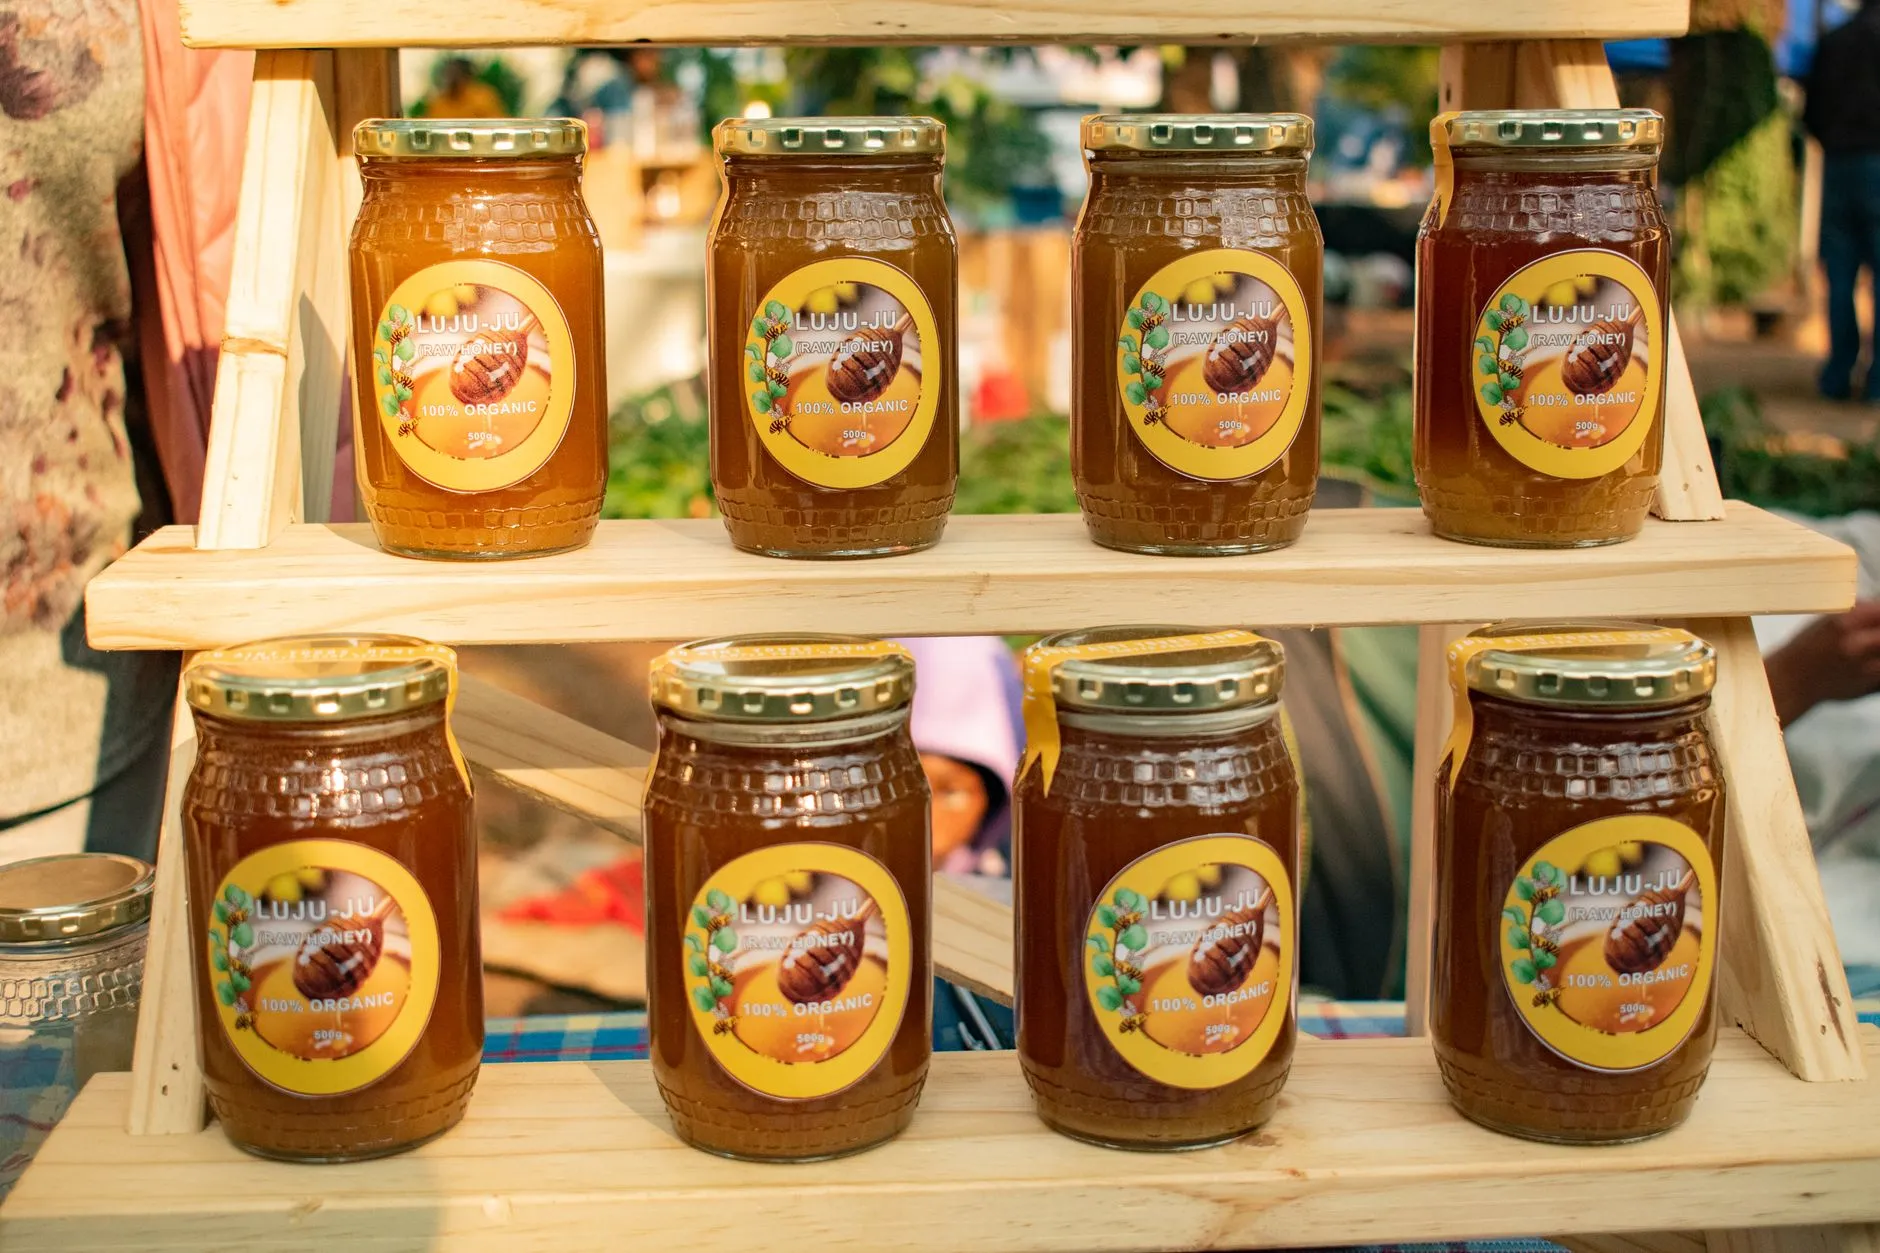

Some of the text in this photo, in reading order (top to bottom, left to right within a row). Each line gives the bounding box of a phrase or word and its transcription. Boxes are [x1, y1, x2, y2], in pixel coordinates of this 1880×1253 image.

[795, 311, 897, 331] LUJU-JU
[1173, 301, 1272, 322] LUJU-JU
[1532, 304, 1629, 324] LUJU-JU
[417, 313, 520, 334] LUJU-JU
[1172, 330, 1268, 345] (RAW HONEY)
[1531, 333, 1625, 349] (RAW HONEY)
[418, 342, 518, 357] (RAW HONEY)
[796, 340, 893, 357] (RAW HONEY)
[796, 400, 908, 415] 100% ORGANIC
[1173, 390, 1281, 406] 100% ORGANIC
[1530, 392, 1635, 406] 100% ORGANIC
[422, 401, 537, 417] 100% ORGANIC
[843, 430, 866, 440] 500g
[1219, 421, 1242, 430] 500g
[1575, 421, 1598, 431] 500g
[468, 432, 493, 442] 500g
[1569, 868, 1681, 896] LUJU-JU
[256, 896, 375, 920] LUJU-JU
[740, 898, 858, 925] LUJU-JU
[1151, 888, 1259, 921] LUJU-JU
[1569, 902, 1677, 922] (RAW HONEY)
[257, 928, 372, 946] (RAW HONEY)
[742, 932, 854, 951] (RAW HONEY)
[1150, 921, 1257, 945] (RAW HONEY)
[1567, 964, 1689, 989] 100% ORGANIC
[262, 992, 394, 1013] 100% ORGANIC
[743, 993, 872, 1017] 100% ORGANIC
[1152, 981, 1269, 1012] 100% ORGANIC
